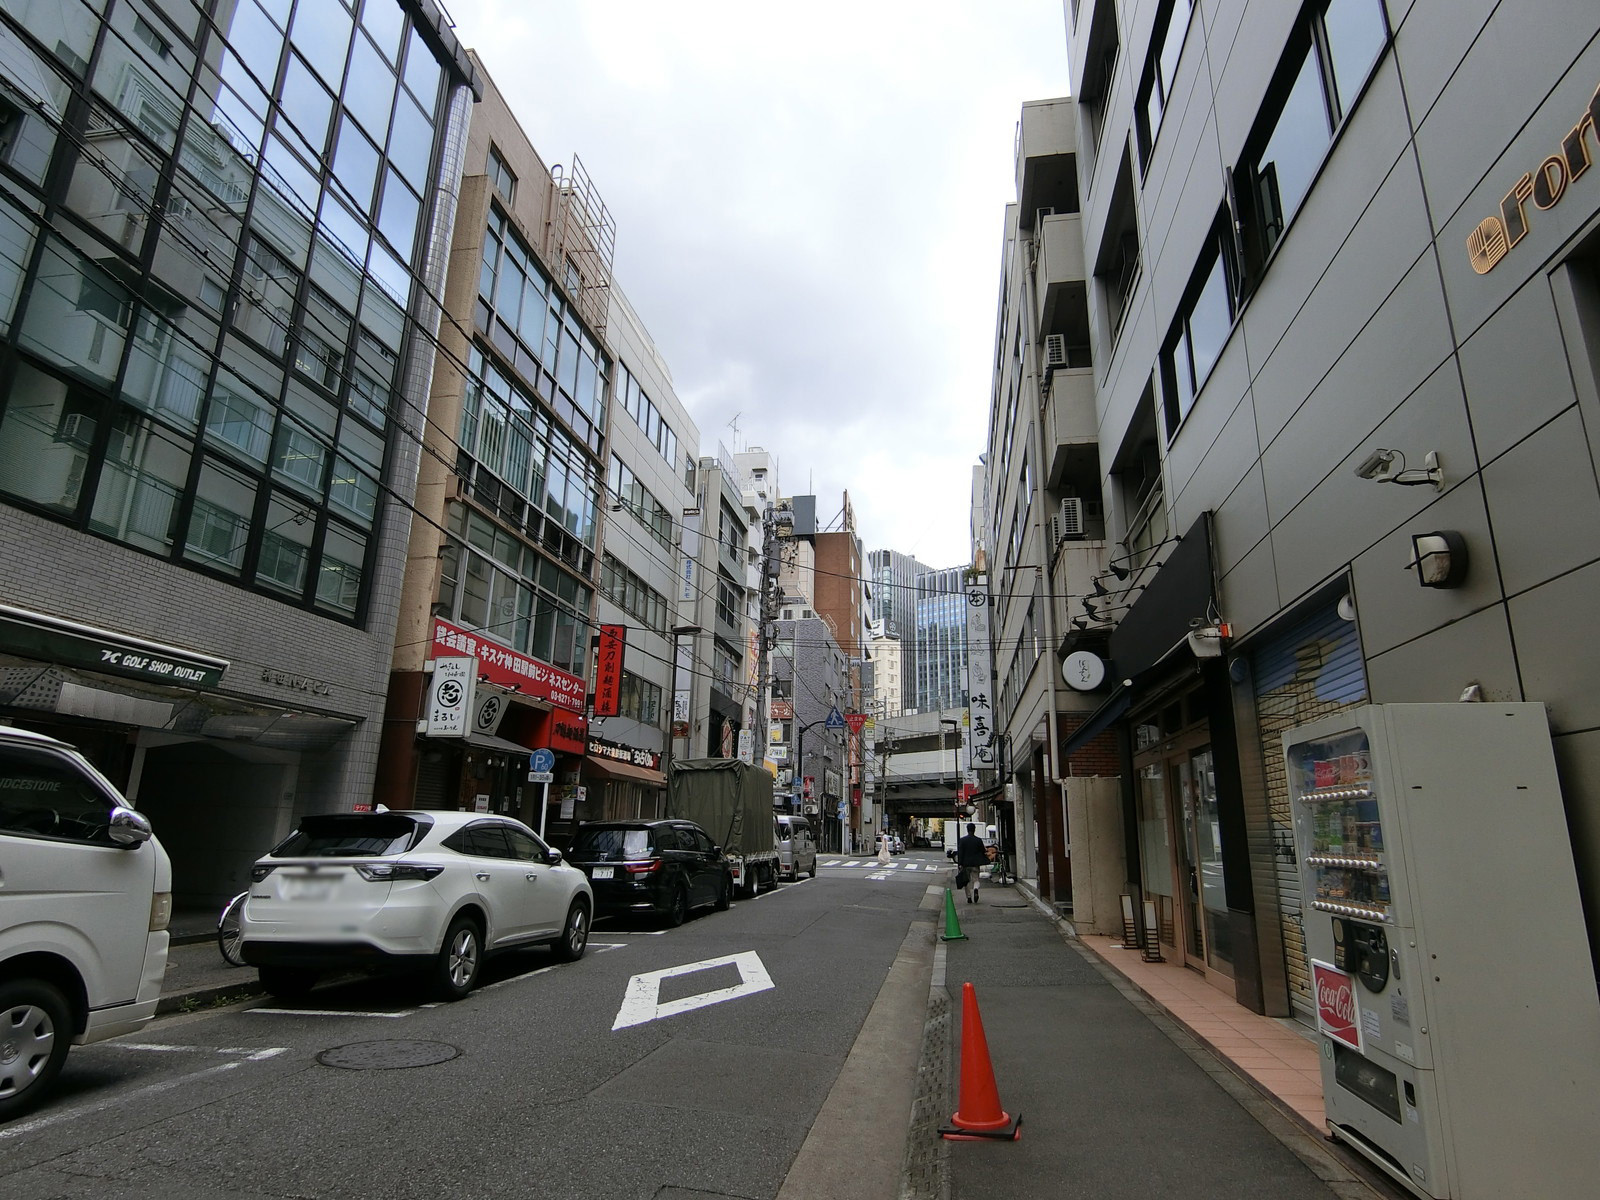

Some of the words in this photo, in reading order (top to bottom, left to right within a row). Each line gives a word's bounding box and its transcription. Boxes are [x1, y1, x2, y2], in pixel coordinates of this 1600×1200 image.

[122, 655, 150, 669] GOLF
[148, 660, 174, 674] SHOP
[173, 666, 207, 682] OUTLET
[971, 692, 994, 763] 味喜庵
[535, 754, 545, 770] P
